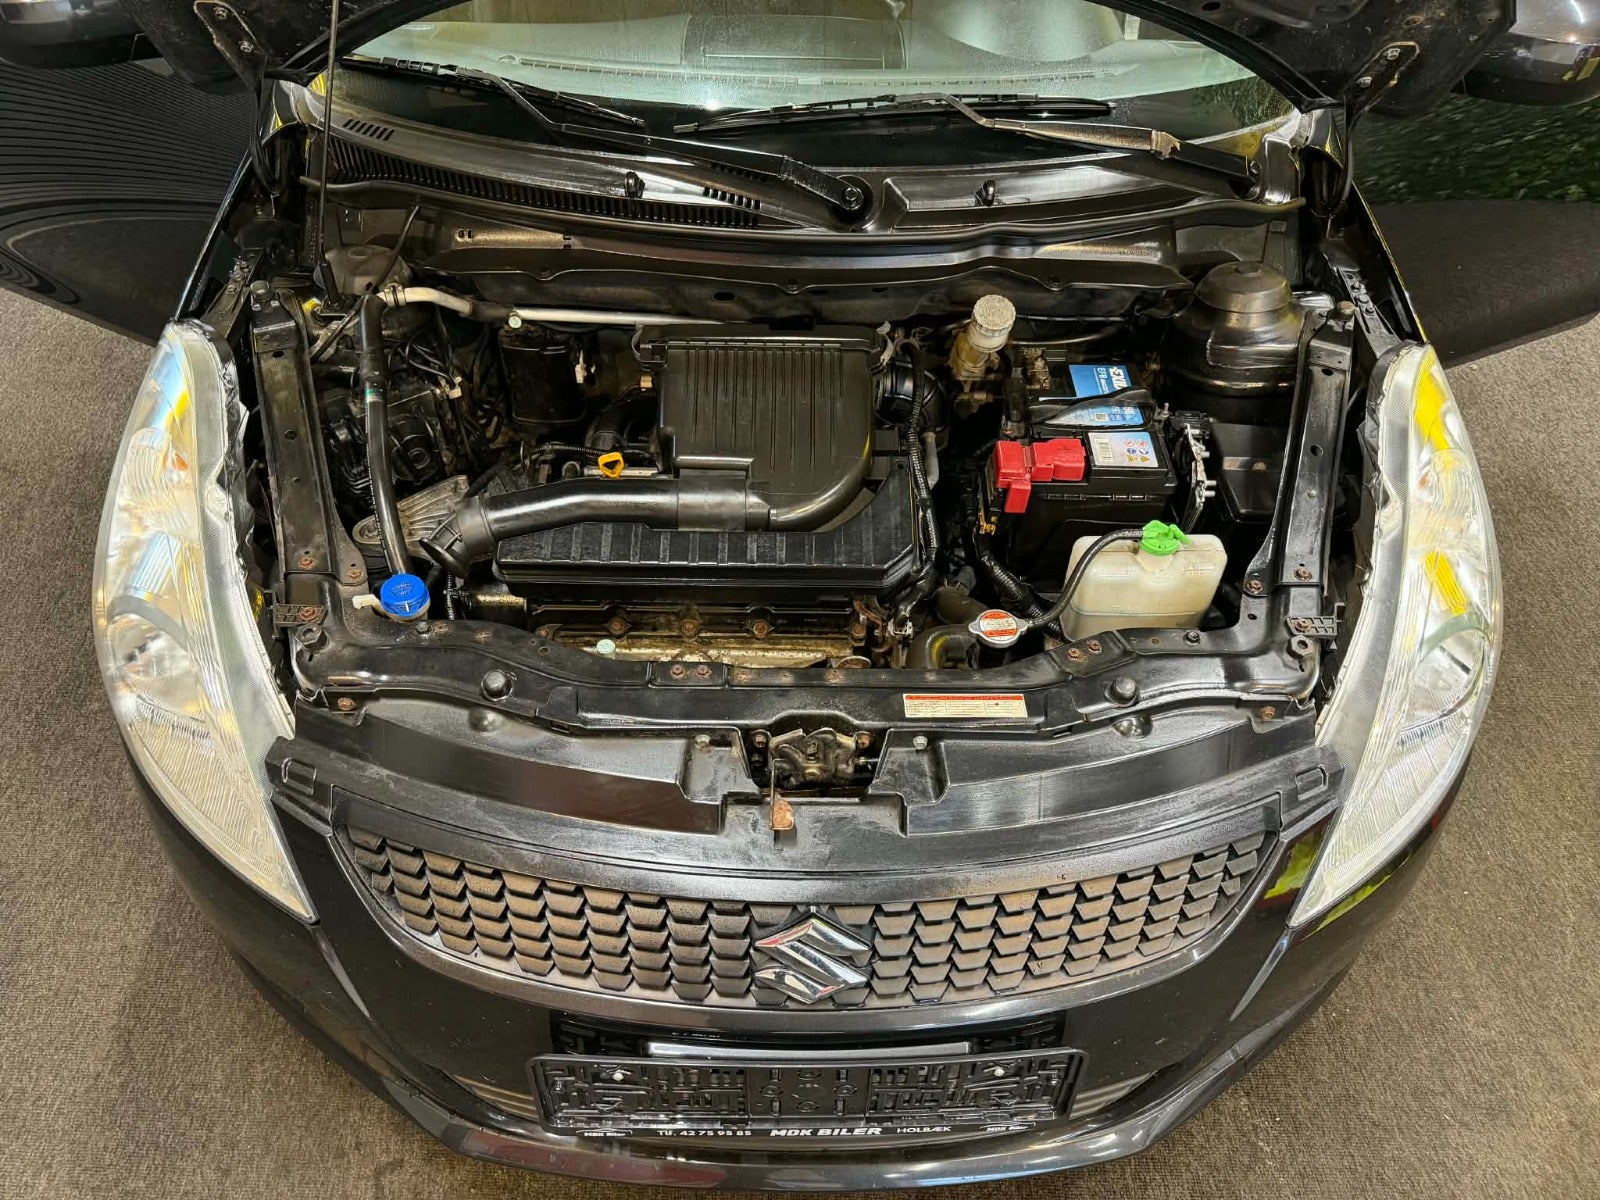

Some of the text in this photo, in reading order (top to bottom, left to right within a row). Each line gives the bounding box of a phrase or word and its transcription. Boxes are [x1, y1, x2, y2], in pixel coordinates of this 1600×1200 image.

[1109, 366, 1129, 390] EXID
[769, 1126, 883, 1137] MDK BILER
[896, 1125, 952, 1134] HOLBÆK
